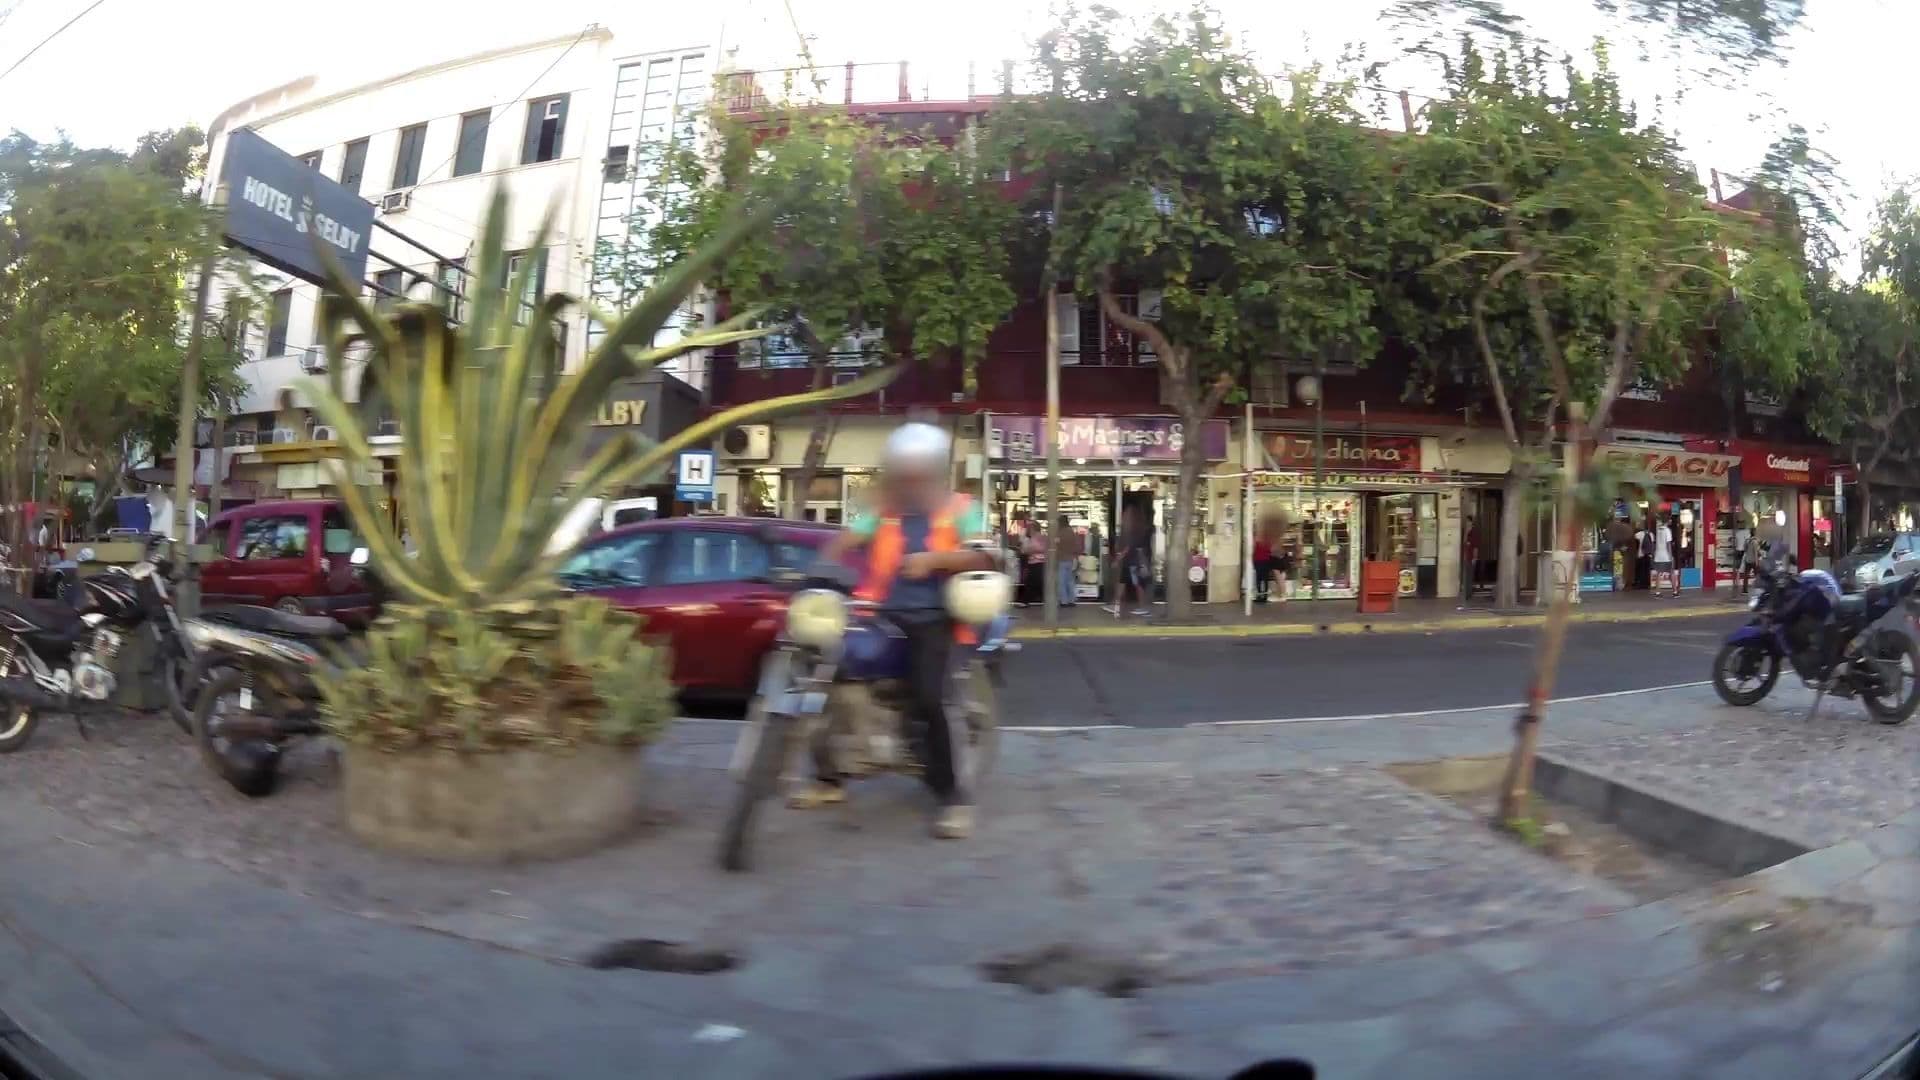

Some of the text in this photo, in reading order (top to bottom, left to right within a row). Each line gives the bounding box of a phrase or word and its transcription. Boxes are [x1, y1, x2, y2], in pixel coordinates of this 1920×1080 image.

[243, 175, 293, 222] HOTEL
[315, 212, 360, 253] SELBY
[688, 459, 704, 480] H
